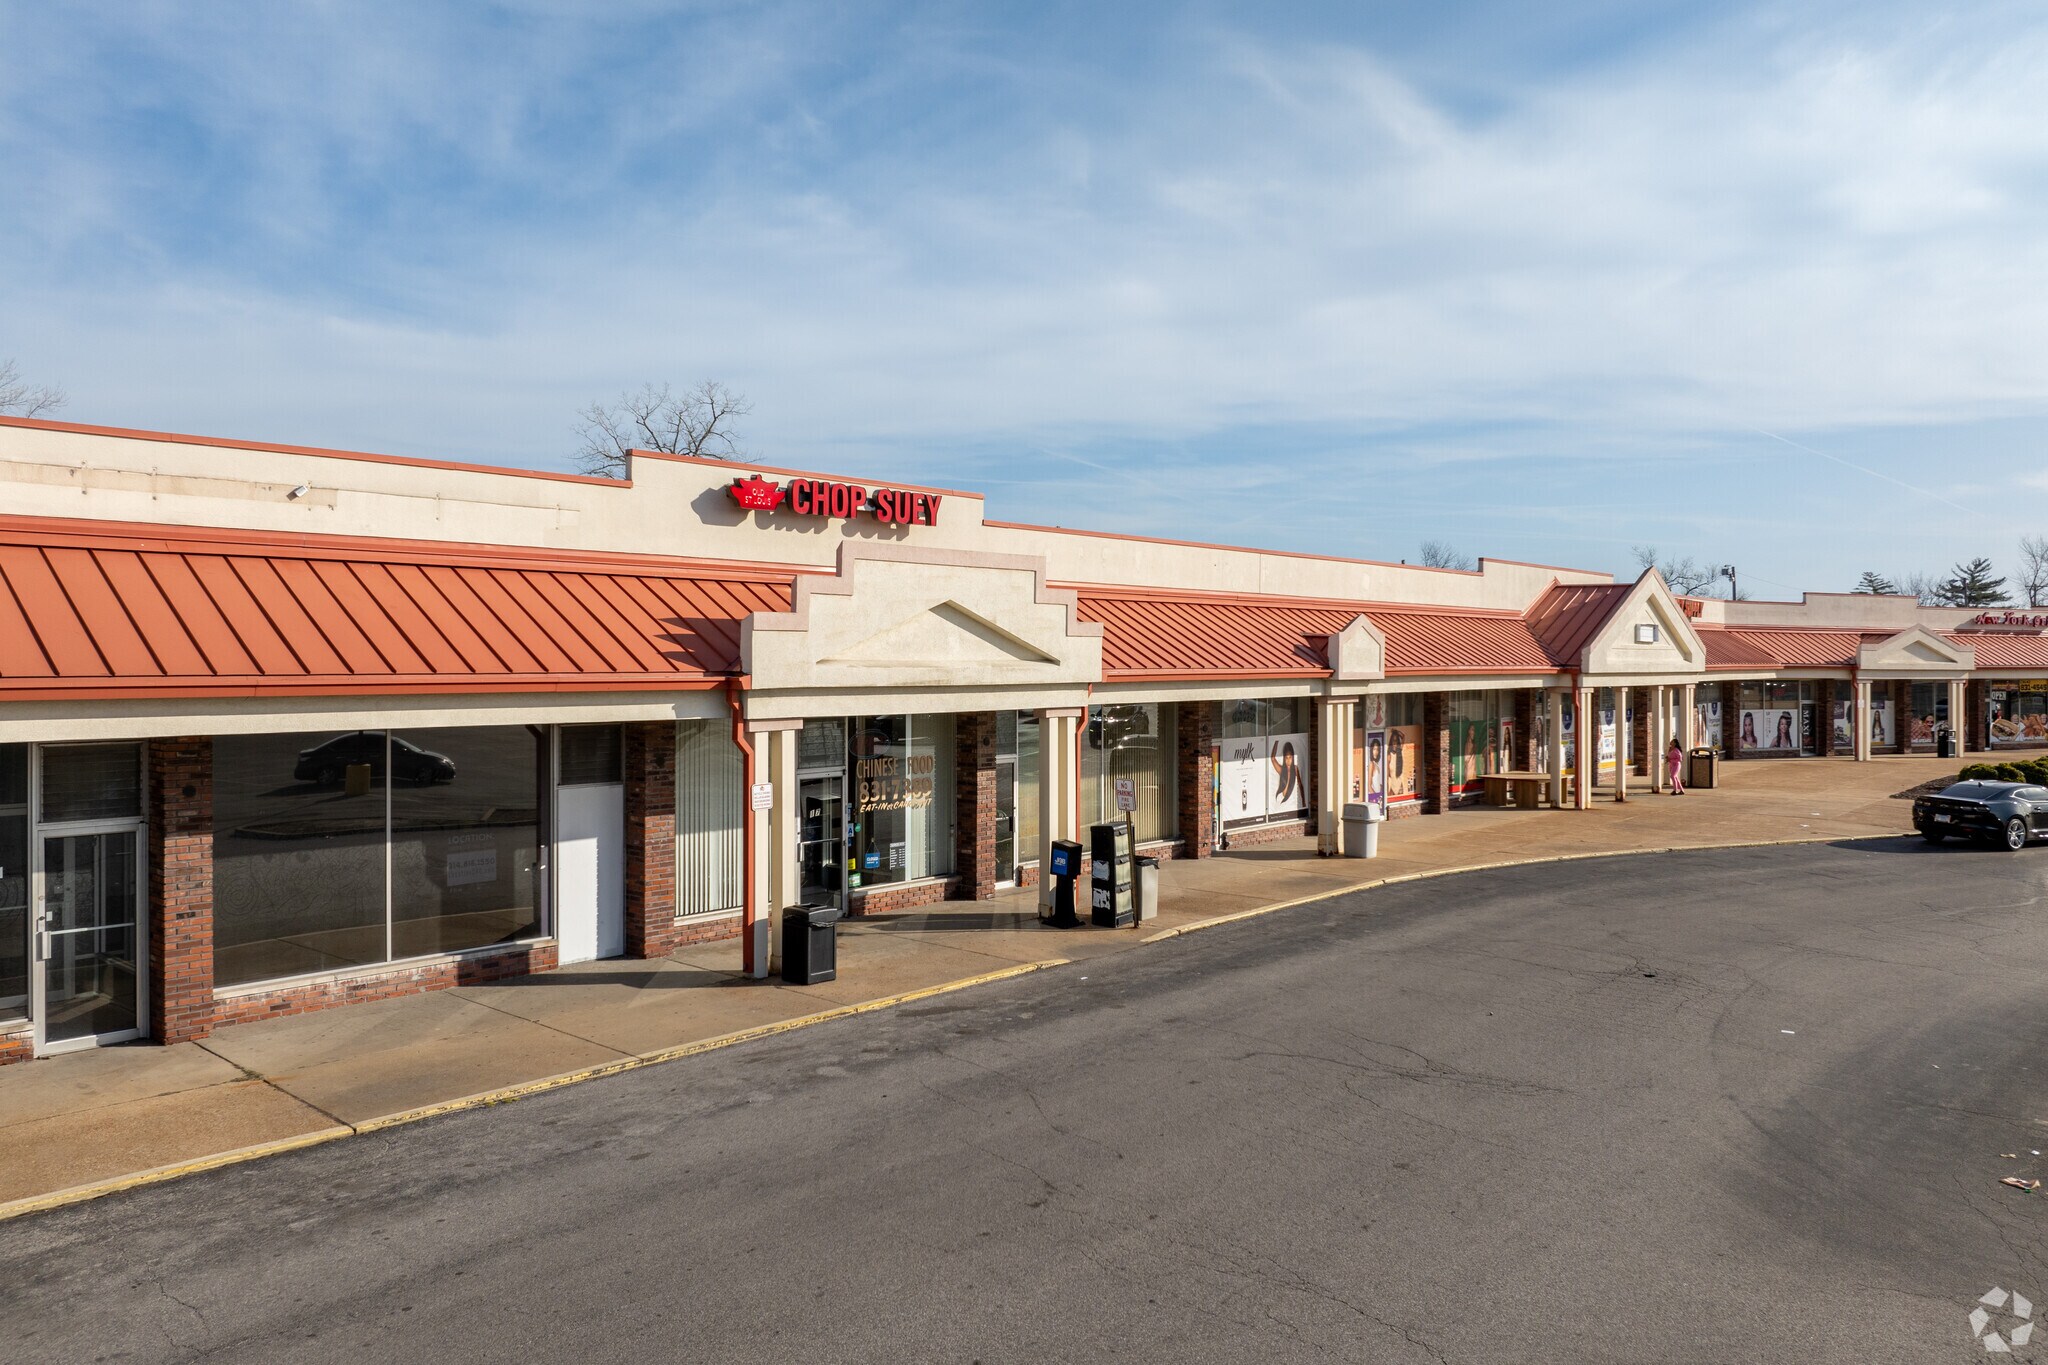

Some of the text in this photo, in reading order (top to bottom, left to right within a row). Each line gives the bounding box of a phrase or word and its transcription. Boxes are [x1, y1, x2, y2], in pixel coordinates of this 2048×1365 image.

[788, 479, 942, 526] CHOP SUEY
[1975, 612, 1998, 625] New
[2003, 612, 2029, 625] York
[1802, 709, 1810, 736] MAXI
[1234, 742, 1255, 765] mylk
[856, 756, 933, 779] CHINESE FOOD
